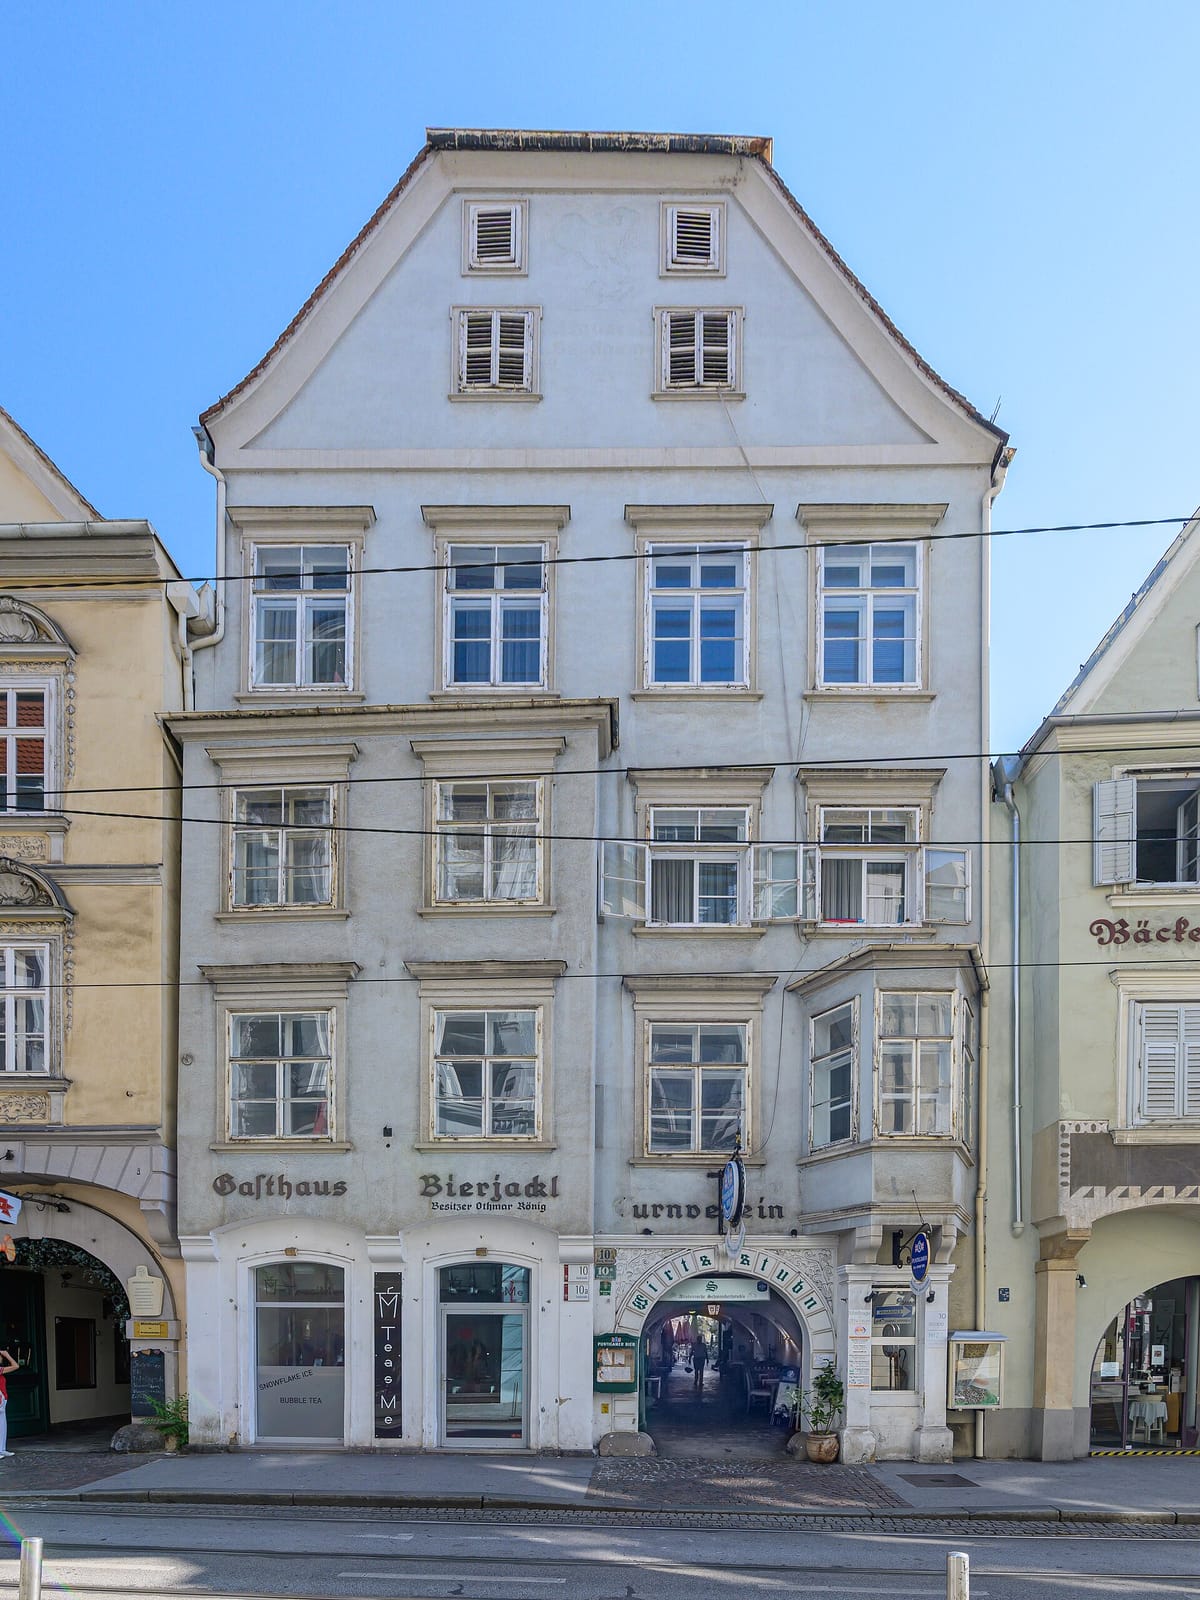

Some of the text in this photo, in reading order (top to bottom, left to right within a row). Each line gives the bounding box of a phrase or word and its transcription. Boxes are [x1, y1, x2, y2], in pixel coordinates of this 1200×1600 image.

[419, 1173, 560, 1202] Bierjackl
[431, 1201, 547, 1213] Besitzer Othmar König
[599, 1248, 611, 1260] 10
[579, 1265, 589, 1276] 10
[258, 1369, 313, 1391] SNOWFLAKE ICE
[279, 1396, 323, 1404] BUBBLE TEA
